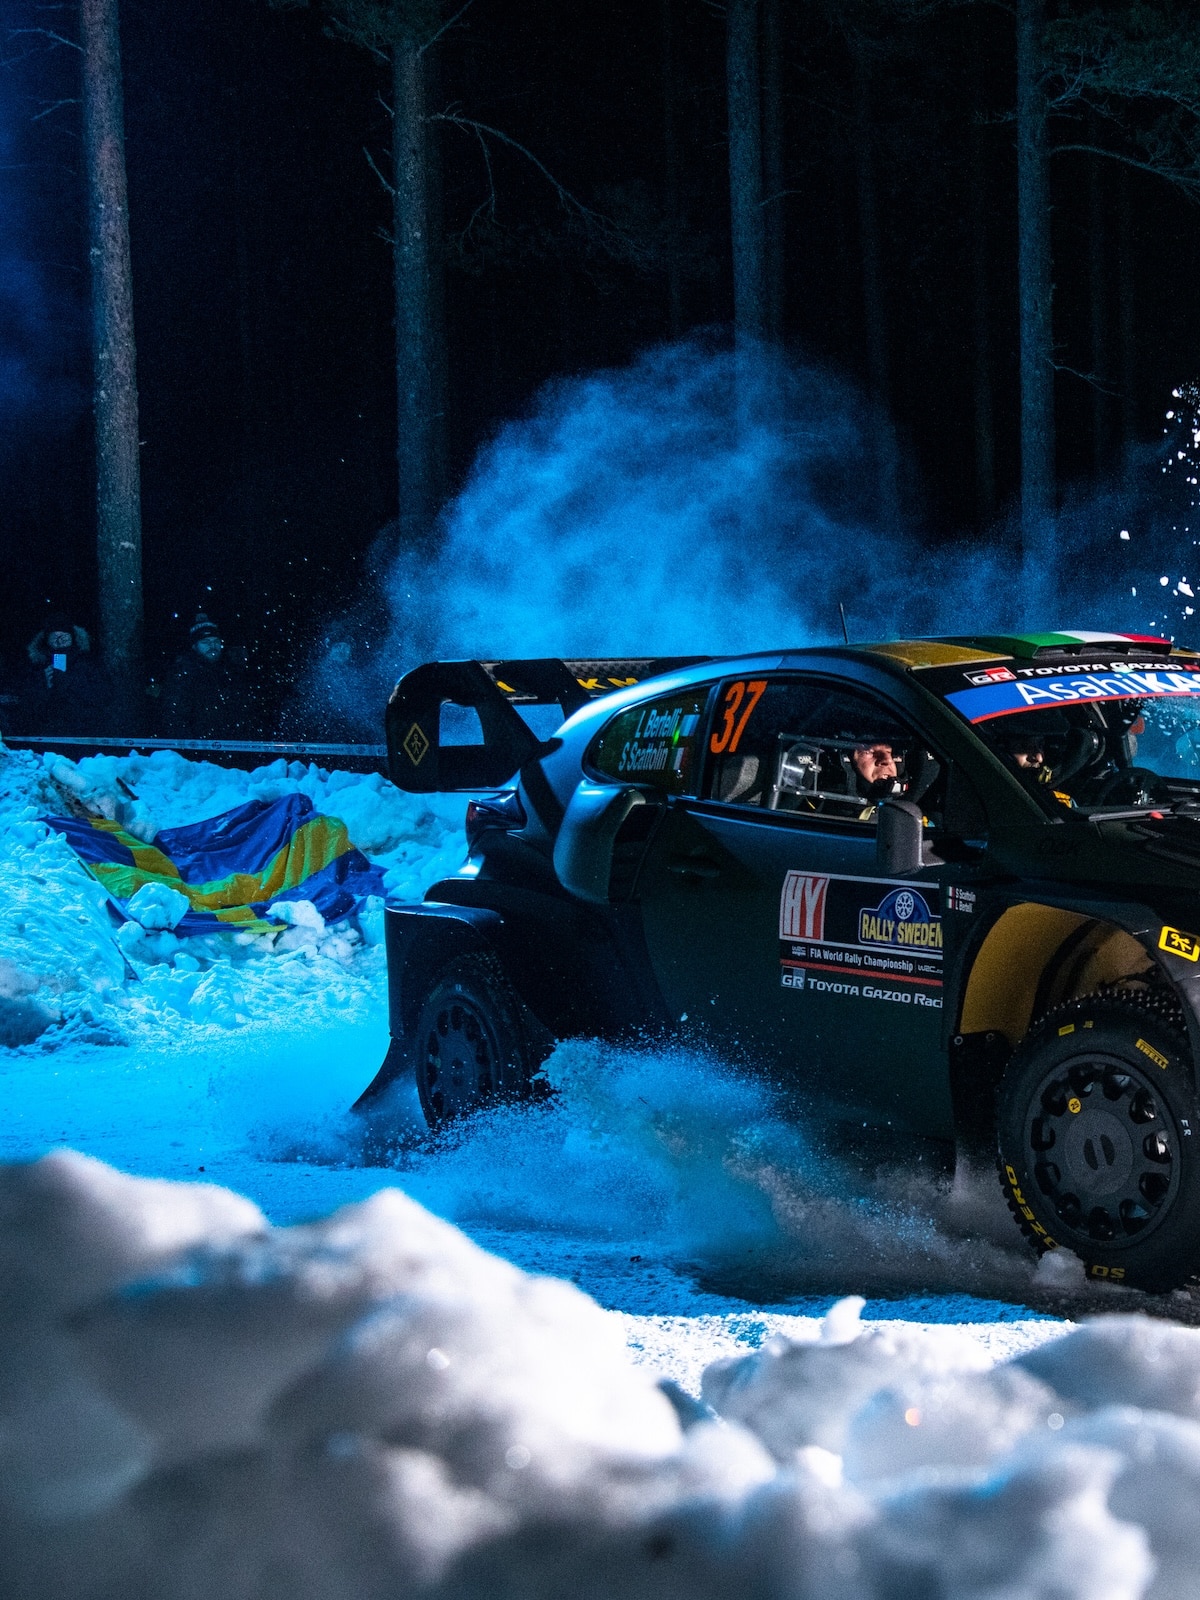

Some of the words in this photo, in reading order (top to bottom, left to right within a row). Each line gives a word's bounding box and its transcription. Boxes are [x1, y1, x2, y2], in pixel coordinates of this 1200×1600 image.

[972, 671, 1012, 685] GR
[1017, 663, 1107, 677] TOYOTA
[634, 710, 646, 738] L
[643, 708, 683, 738] Bertelli
[710, 681, 768, 754] 37
[618, 742, 630, 772] S
[627, 741, 669, 771] Scattolin
[783, 875, 826, 938] HY
[862, 913, 895, 942] RALLY
[897, 921, 943, 948] SWEDEN
[810, 948, 822, 959] FIA
[823, 950, 843, 962] World
[844, 953, 862, 966] Rally
[863, 956, 914, 973] Championship
[782, 975, 804, 987] GR
[808, 977, 859, 996] TOYOTA
[862, 986, 911, 1004] GAZOO
